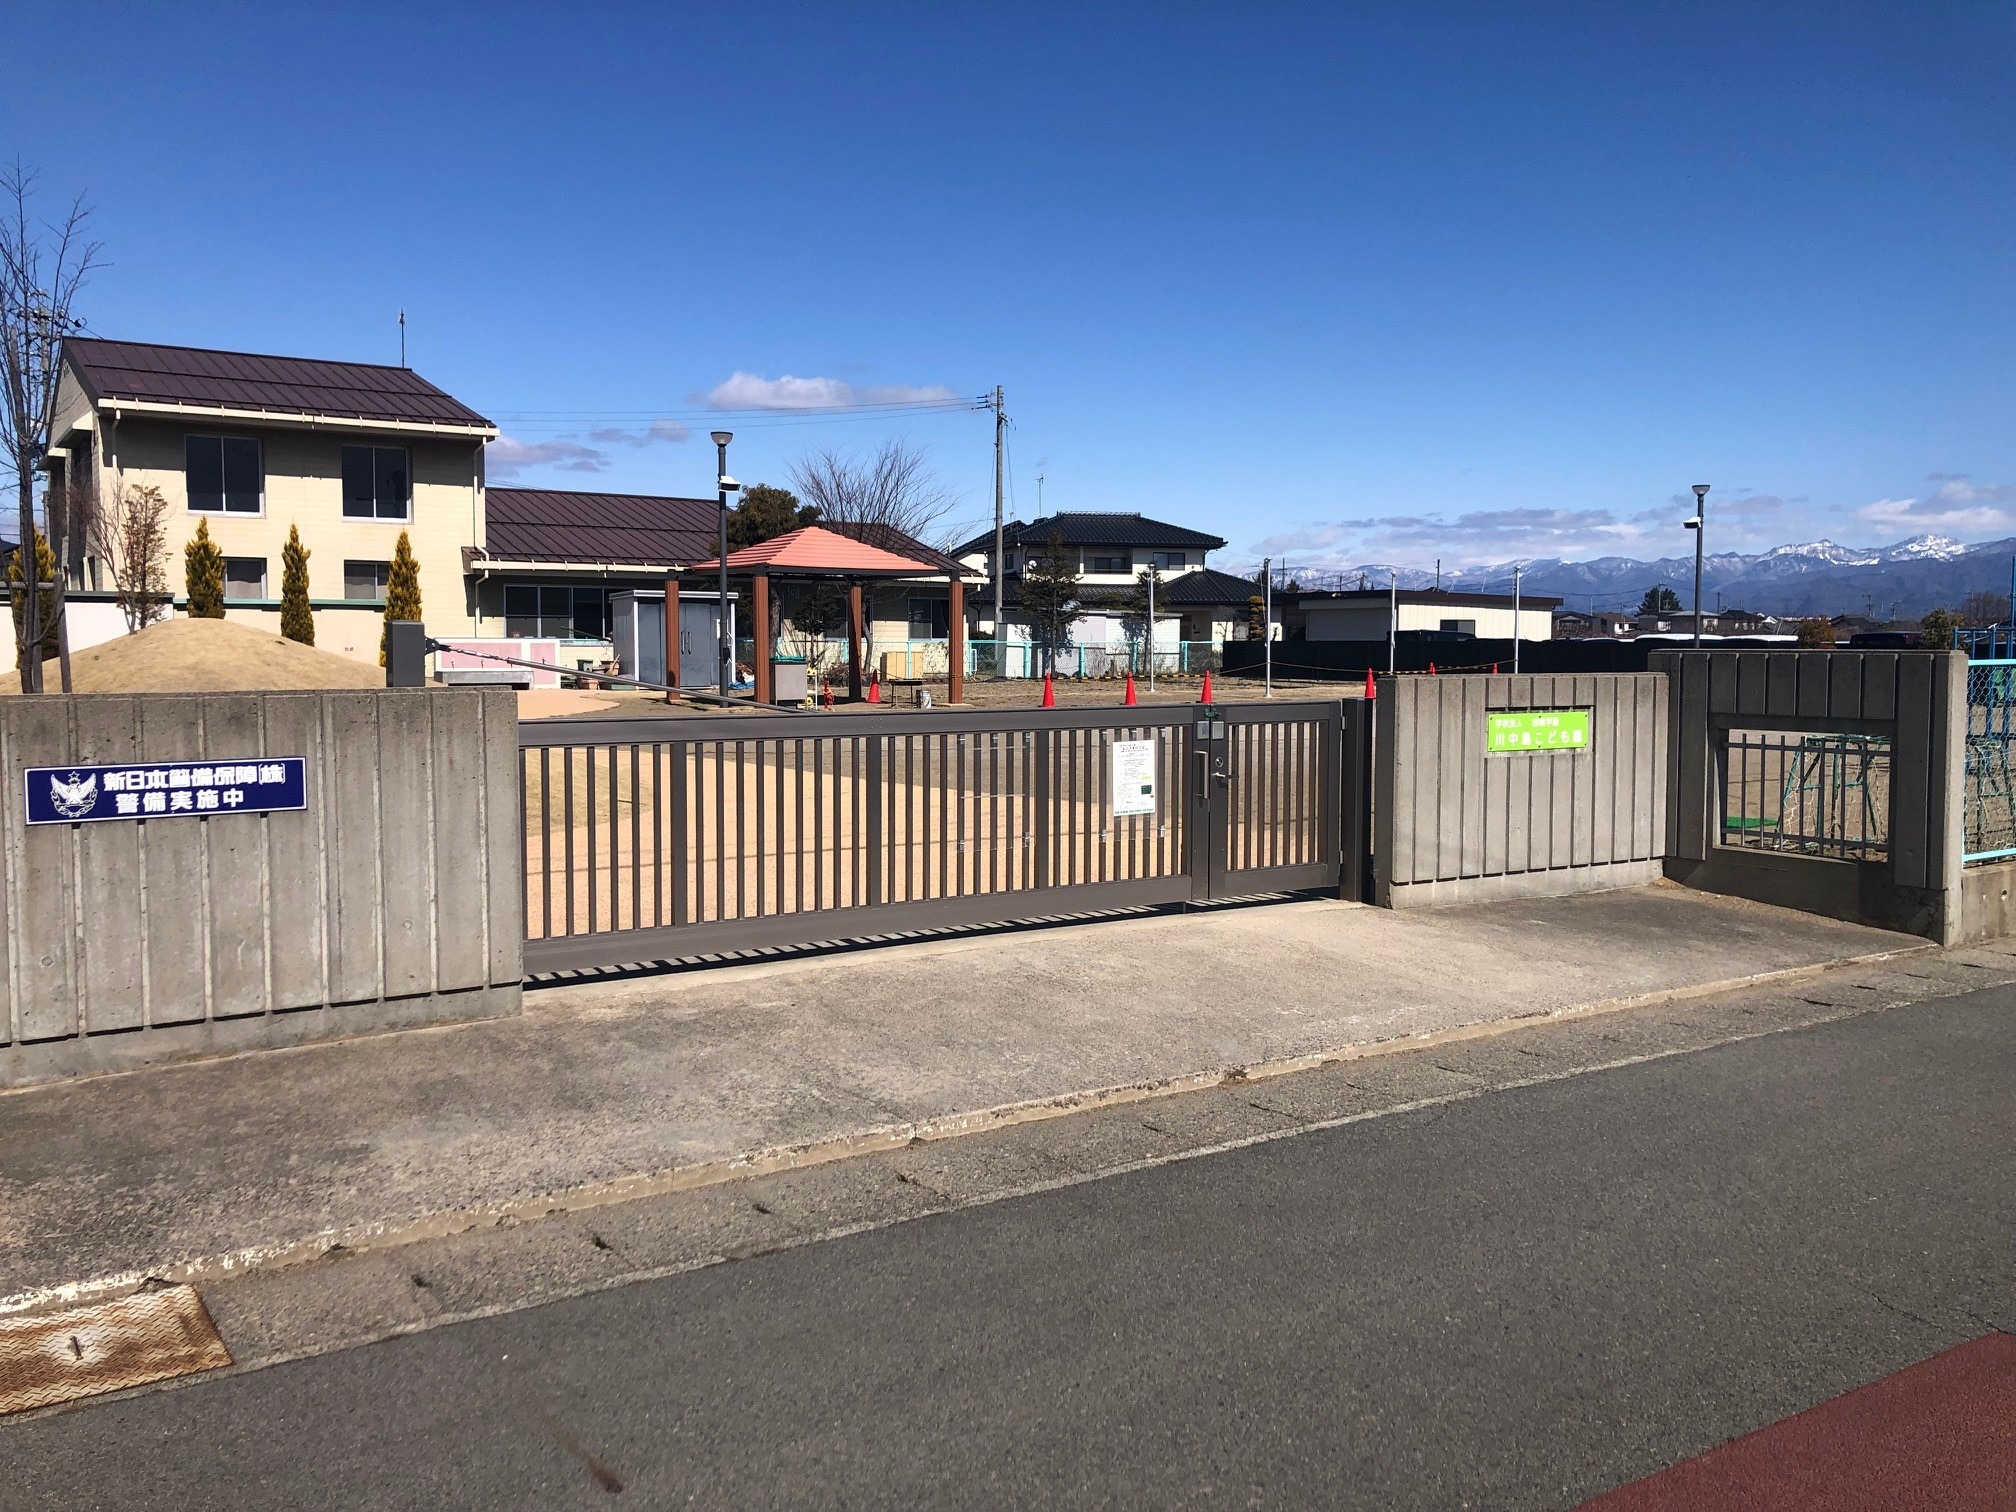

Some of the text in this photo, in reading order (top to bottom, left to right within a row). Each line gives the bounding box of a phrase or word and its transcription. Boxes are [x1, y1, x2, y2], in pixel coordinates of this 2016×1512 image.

[115, 788, 244, 813] 警備実施中
